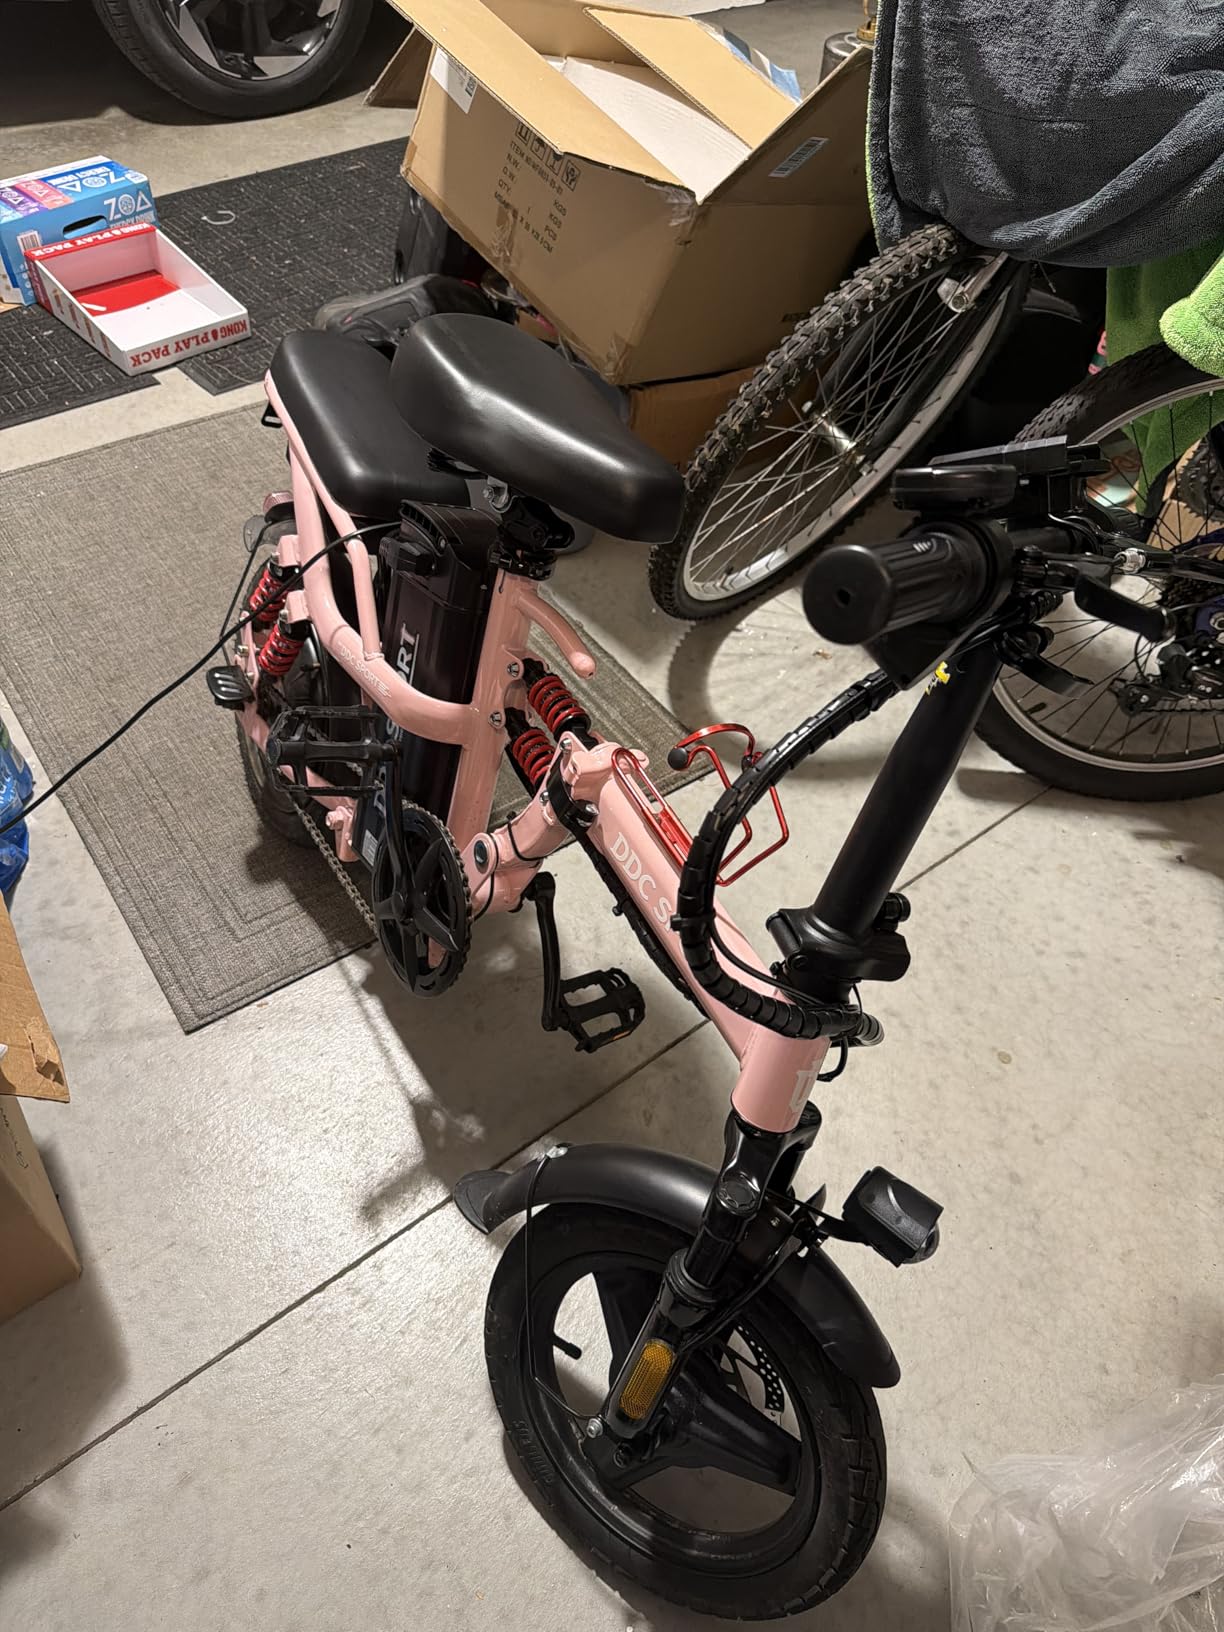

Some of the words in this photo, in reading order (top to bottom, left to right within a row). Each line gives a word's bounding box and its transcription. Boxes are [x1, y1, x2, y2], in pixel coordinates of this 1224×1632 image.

[104, 190, 152, 221] ZOA
[31, 241, 74, 257] PACK
[75, 230, 112, 246] PLAY
[220, 320, 247, 338] KONG
[173, 331, 210, 353] PLAY
[130, 344, 172, 368] PACK
[609, 831, 657, 903] DDC
